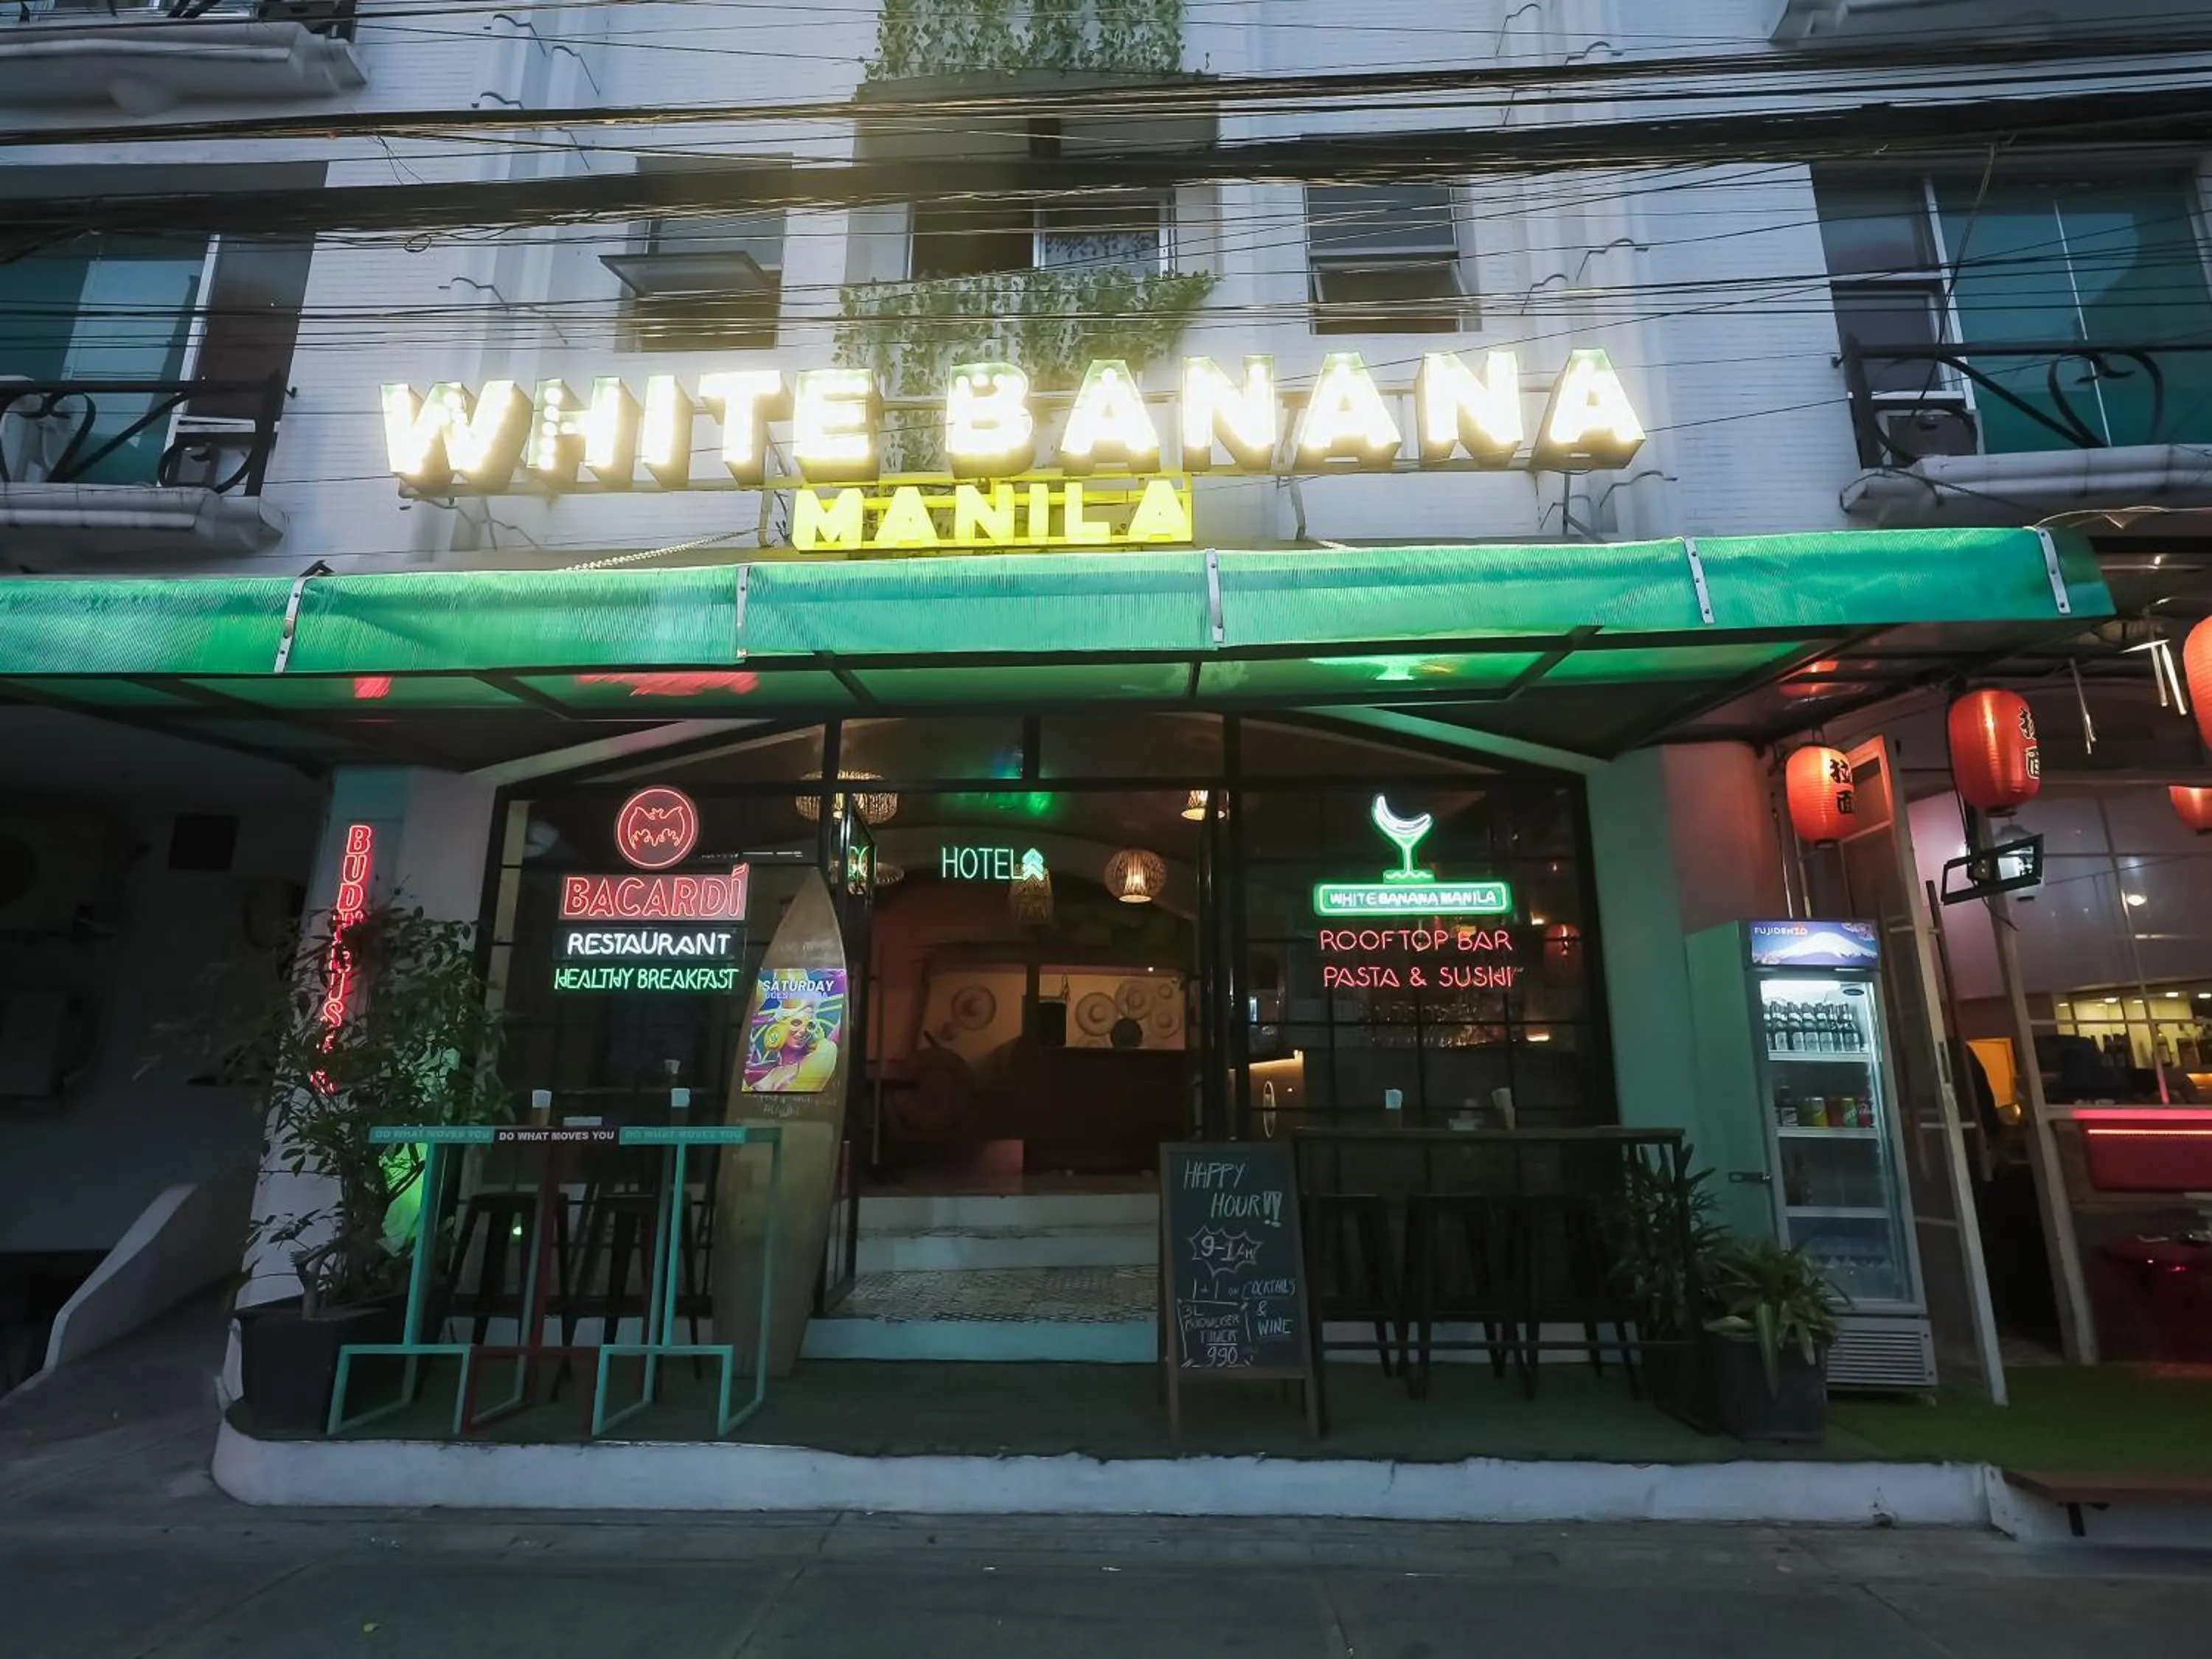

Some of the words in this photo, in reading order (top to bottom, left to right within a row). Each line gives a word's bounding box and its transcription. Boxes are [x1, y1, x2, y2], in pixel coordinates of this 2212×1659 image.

[381, 369, 883, 493] WHITE
[946, 348, 1646, 479] BANANA
[793, 480, 1192, 550] MANILA
[942, 846, 1023, 880] HOTEL
[564, 863, 747, 917] BACARDÍ
[1329, 892, 1377, 906] WHITE
[1378, 891, 1439, 905] BANANA
[1440, 890, 1496, 905] MANILA
[567, 931, 731, 956] RESTAURANT
[1320, 930, 1449, 952] ROOFTOP
[1457, 931, 1512, 951] BAR
[554, 967, 636, 990] HEALTHY
[637, 967, 740, 990] BREAKFAST
[762, 979, 835, 992] SATURDAY
[1324, 966, 1400, 988] PASTA
[1409, 966, 1427, 987] &
[1439, 966, 1512, 988] SUSHI
[498, 1131, 515, 1141] DO
[517, 1131, 549, 1141] WHAT
[551, 1130, 590, 1141] MOVES
[591, 1130, 615, 1140] YOU
[1183, 1158, 1246, 1191] HAPPY
[1256, 1300, 1268, 1317] &
[1257, 1317, 1293, 1337] WINE
[1206, 1346, 1239, 1368] 990
